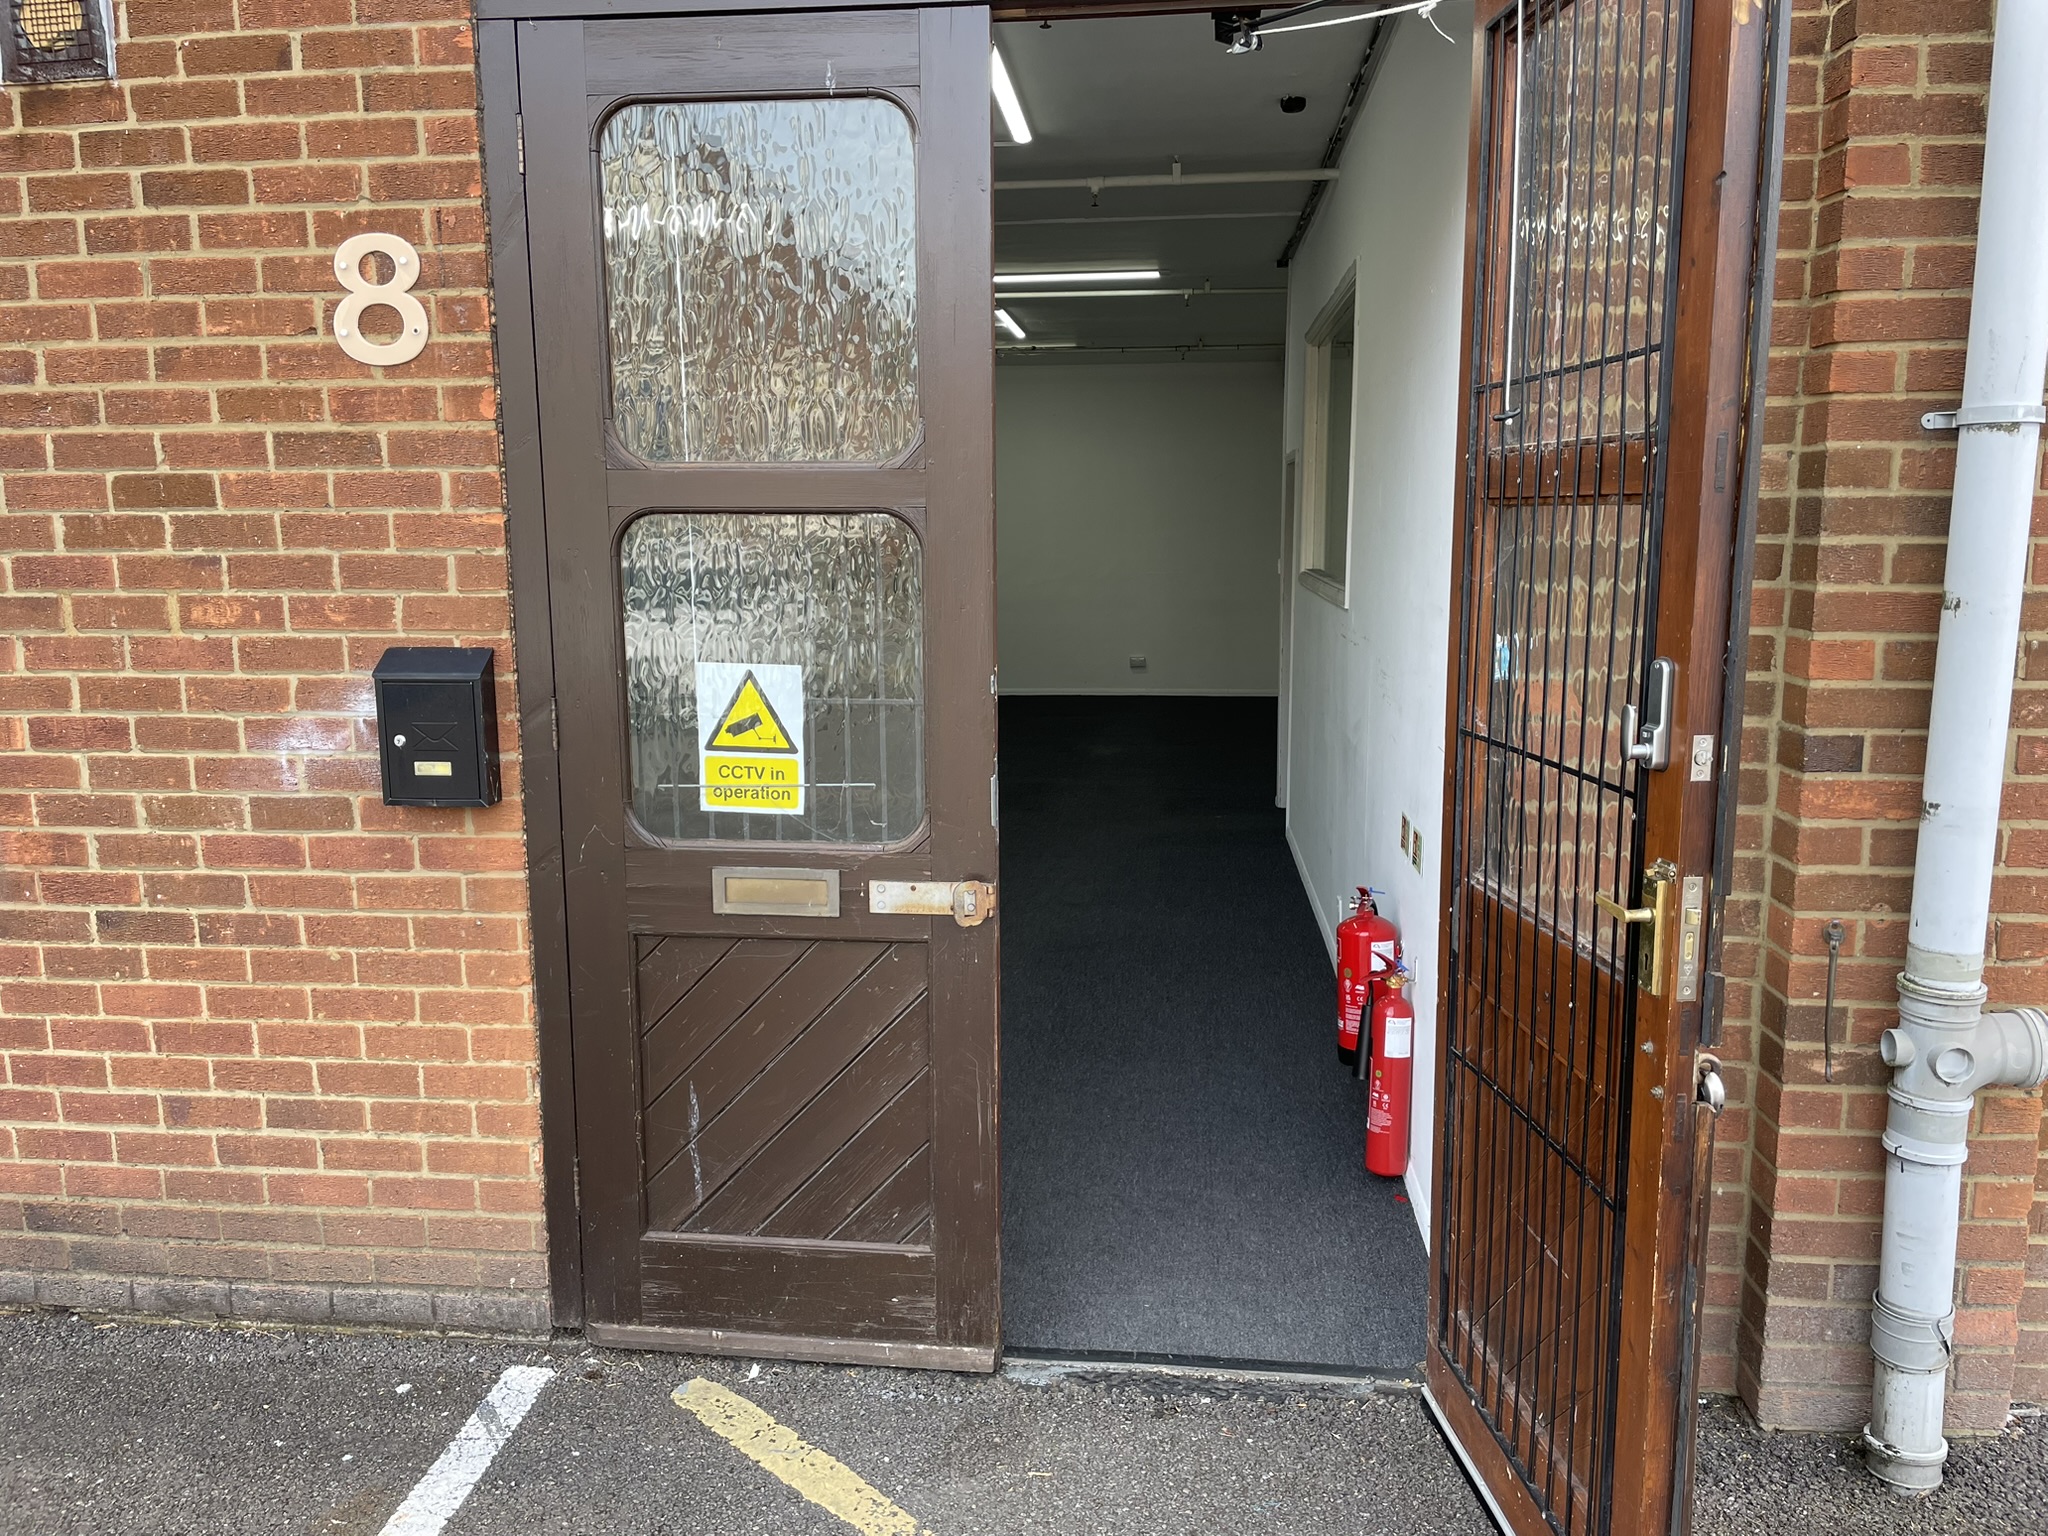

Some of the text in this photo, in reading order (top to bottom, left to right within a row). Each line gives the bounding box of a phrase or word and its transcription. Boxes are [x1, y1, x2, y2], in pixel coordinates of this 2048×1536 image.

[333, 232, 429, 366] 8
[718, 764, 785, 781] CCTV in
[713, 785, 791, 801] operation
